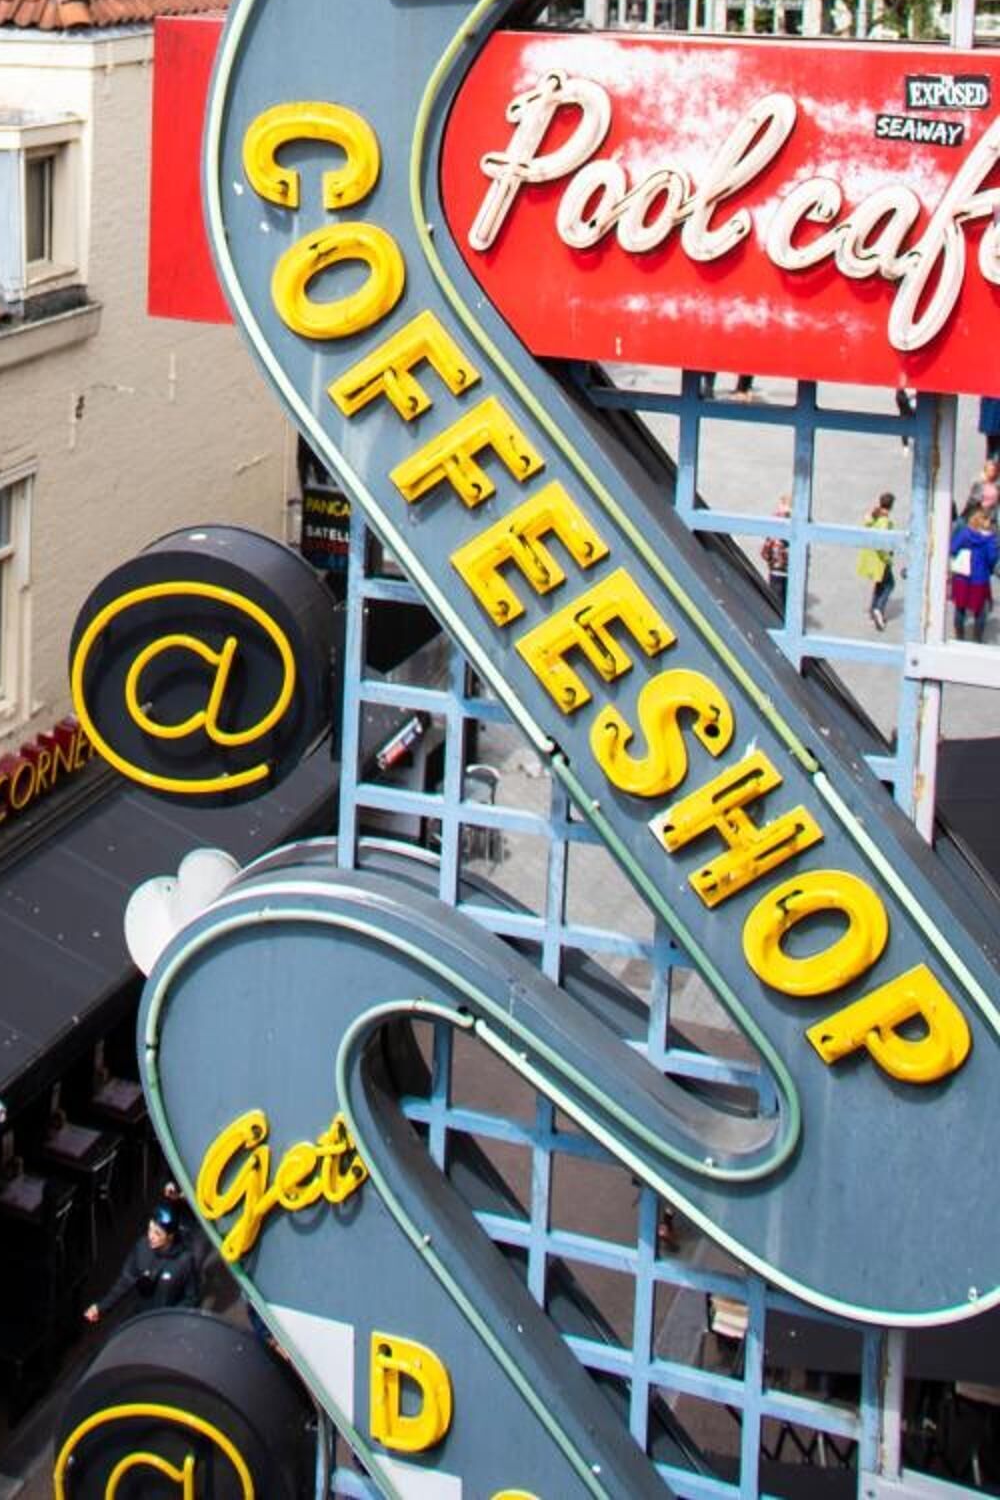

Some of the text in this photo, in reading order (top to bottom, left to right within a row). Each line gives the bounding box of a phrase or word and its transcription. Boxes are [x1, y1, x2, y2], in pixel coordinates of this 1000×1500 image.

[877, 116, 963, 145] SEAWAY
[908, 81, 988, 107] EXPOSED
[468, 68, 798, 262] Pool
[241, 100, 974, 1084] COFFEESHOP
